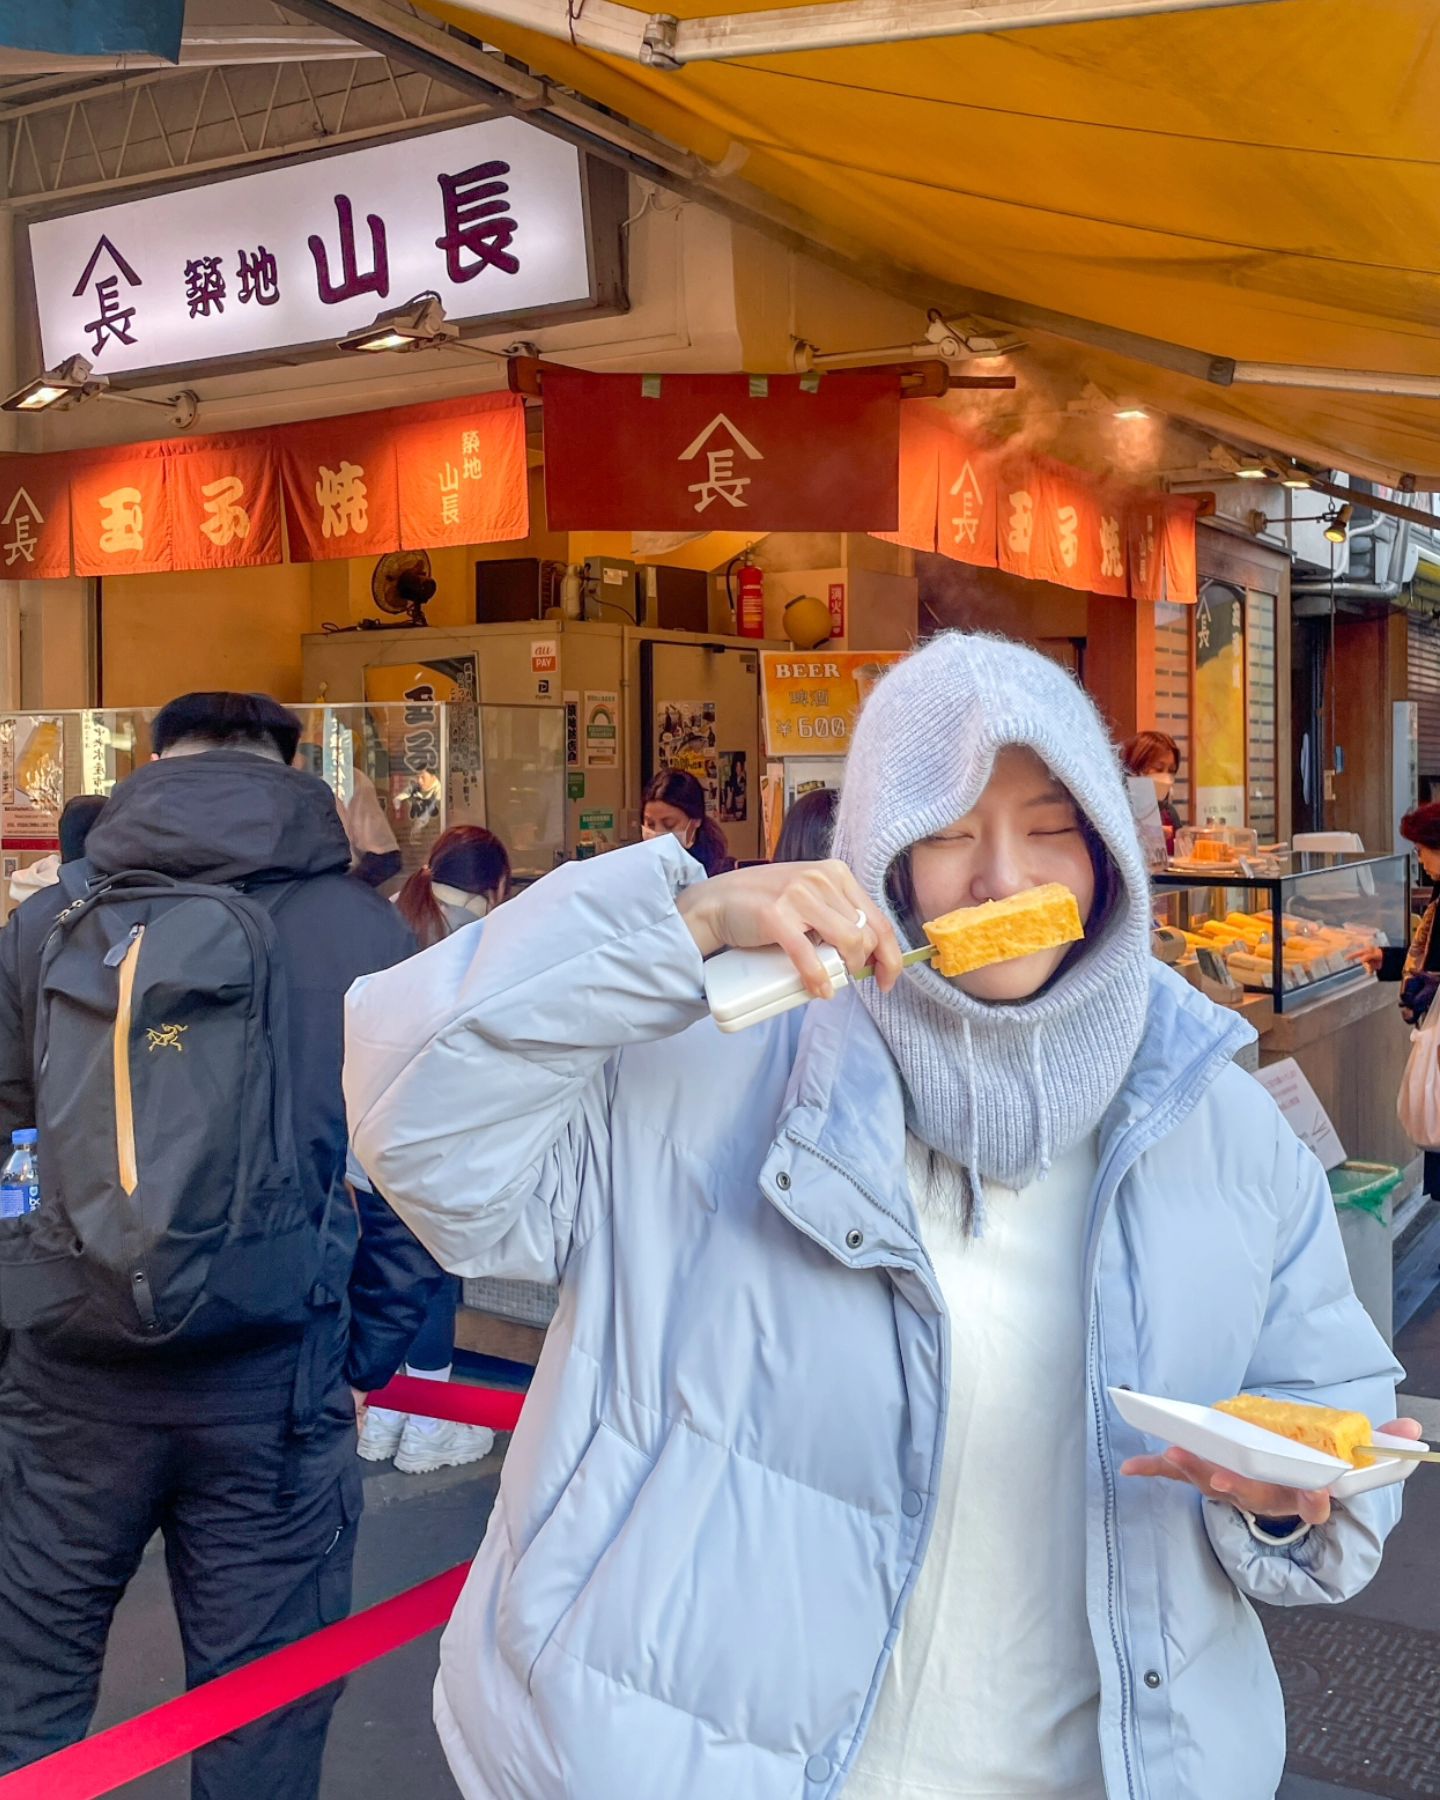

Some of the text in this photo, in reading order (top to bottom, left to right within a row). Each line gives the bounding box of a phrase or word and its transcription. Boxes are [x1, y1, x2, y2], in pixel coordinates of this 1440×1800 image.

[83, 275, 138, 356] 長
[438, 463, 460, 526] 山長
[688, 449, 751, 513] 長
[2, 516, 38, 563] 長
[536, 658, 552, 669] PAY
[775, 663, 841, 679] BEER
